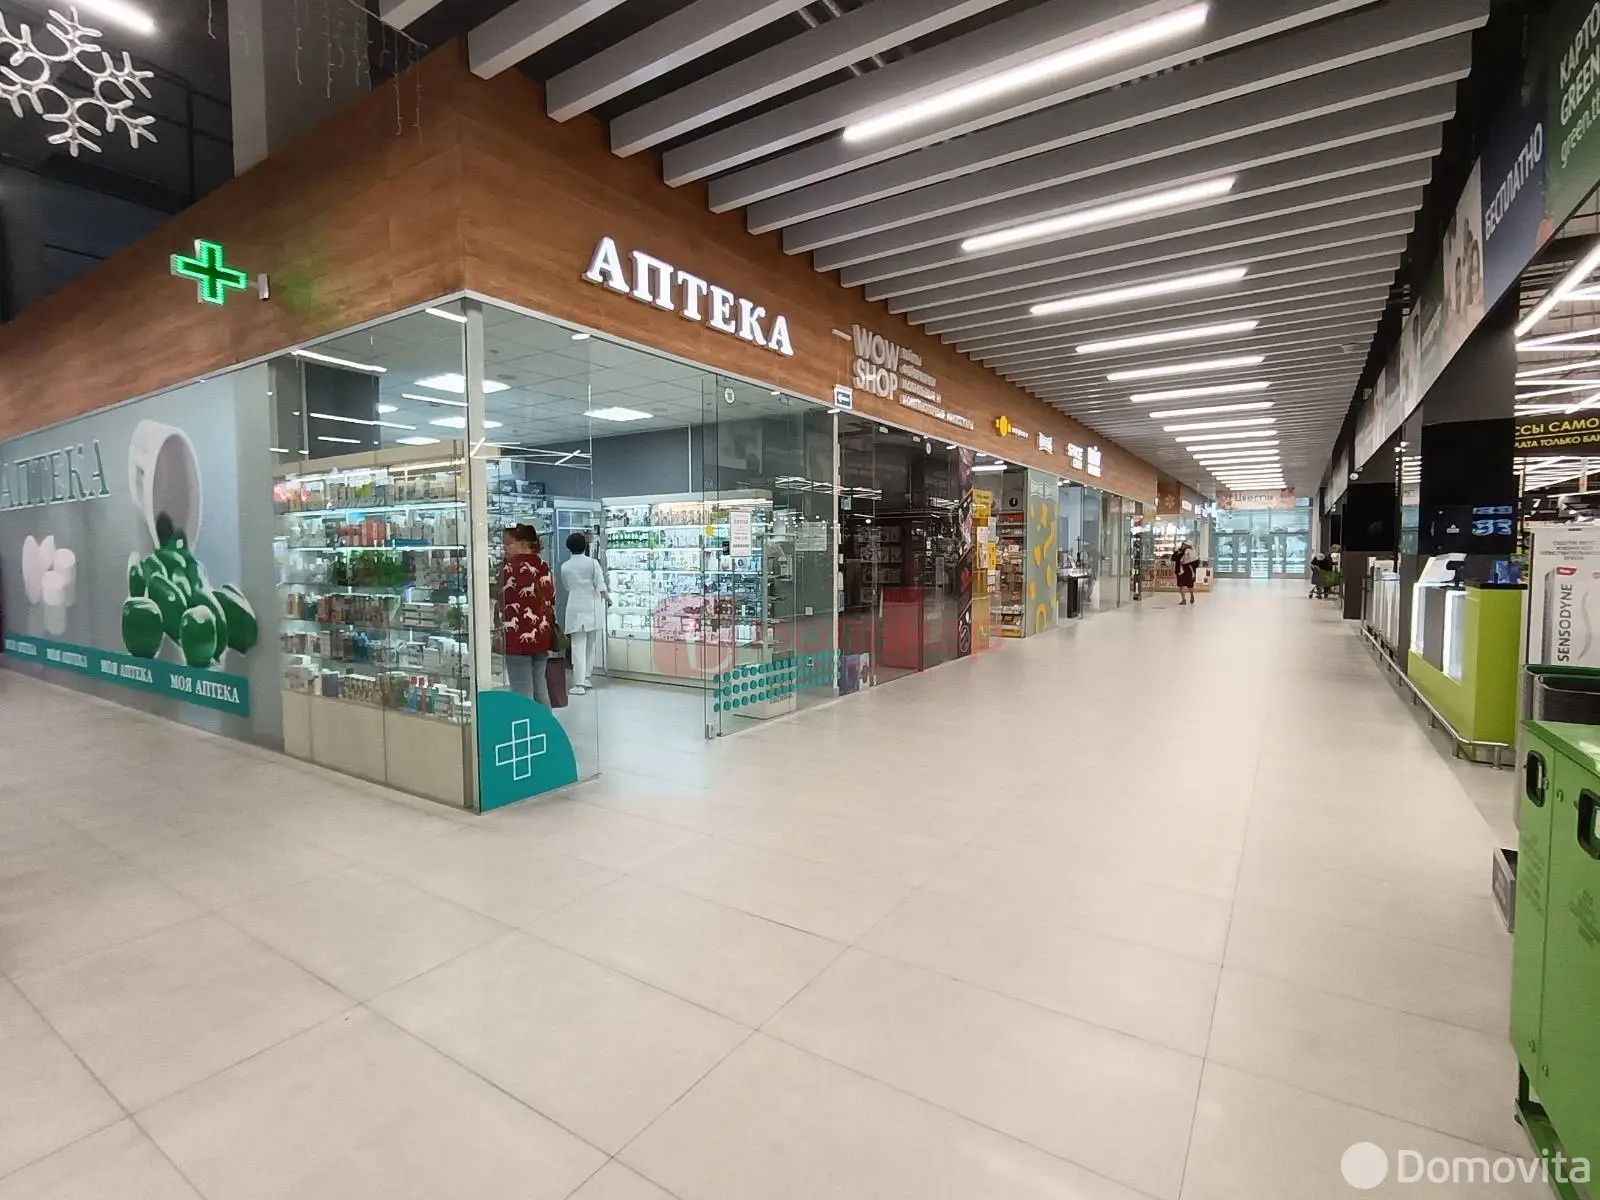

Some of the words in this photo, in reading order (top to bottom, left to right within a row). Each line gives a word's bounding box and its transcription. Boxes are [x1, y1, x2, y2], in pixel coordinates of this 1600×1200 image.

[1485, 122, 1543, 241] БЕСПЛАТНО
[582, 236, 794, 357] АПТЕКА
[852, 324, 900, 372] WOW
[853, 358, 899, 400] SHOP
[1540, 436, 1581, 446] ТОЛЬКО
[1548, 417, 1600, 432] САМО
[1557, 583, 1573, 663] SENSODYNE
[120, 664, 153, 684] АПТЕКА
[170, 674, 192, 692] МОЯ
[195, 679, 240, 703] АПТЕКА
